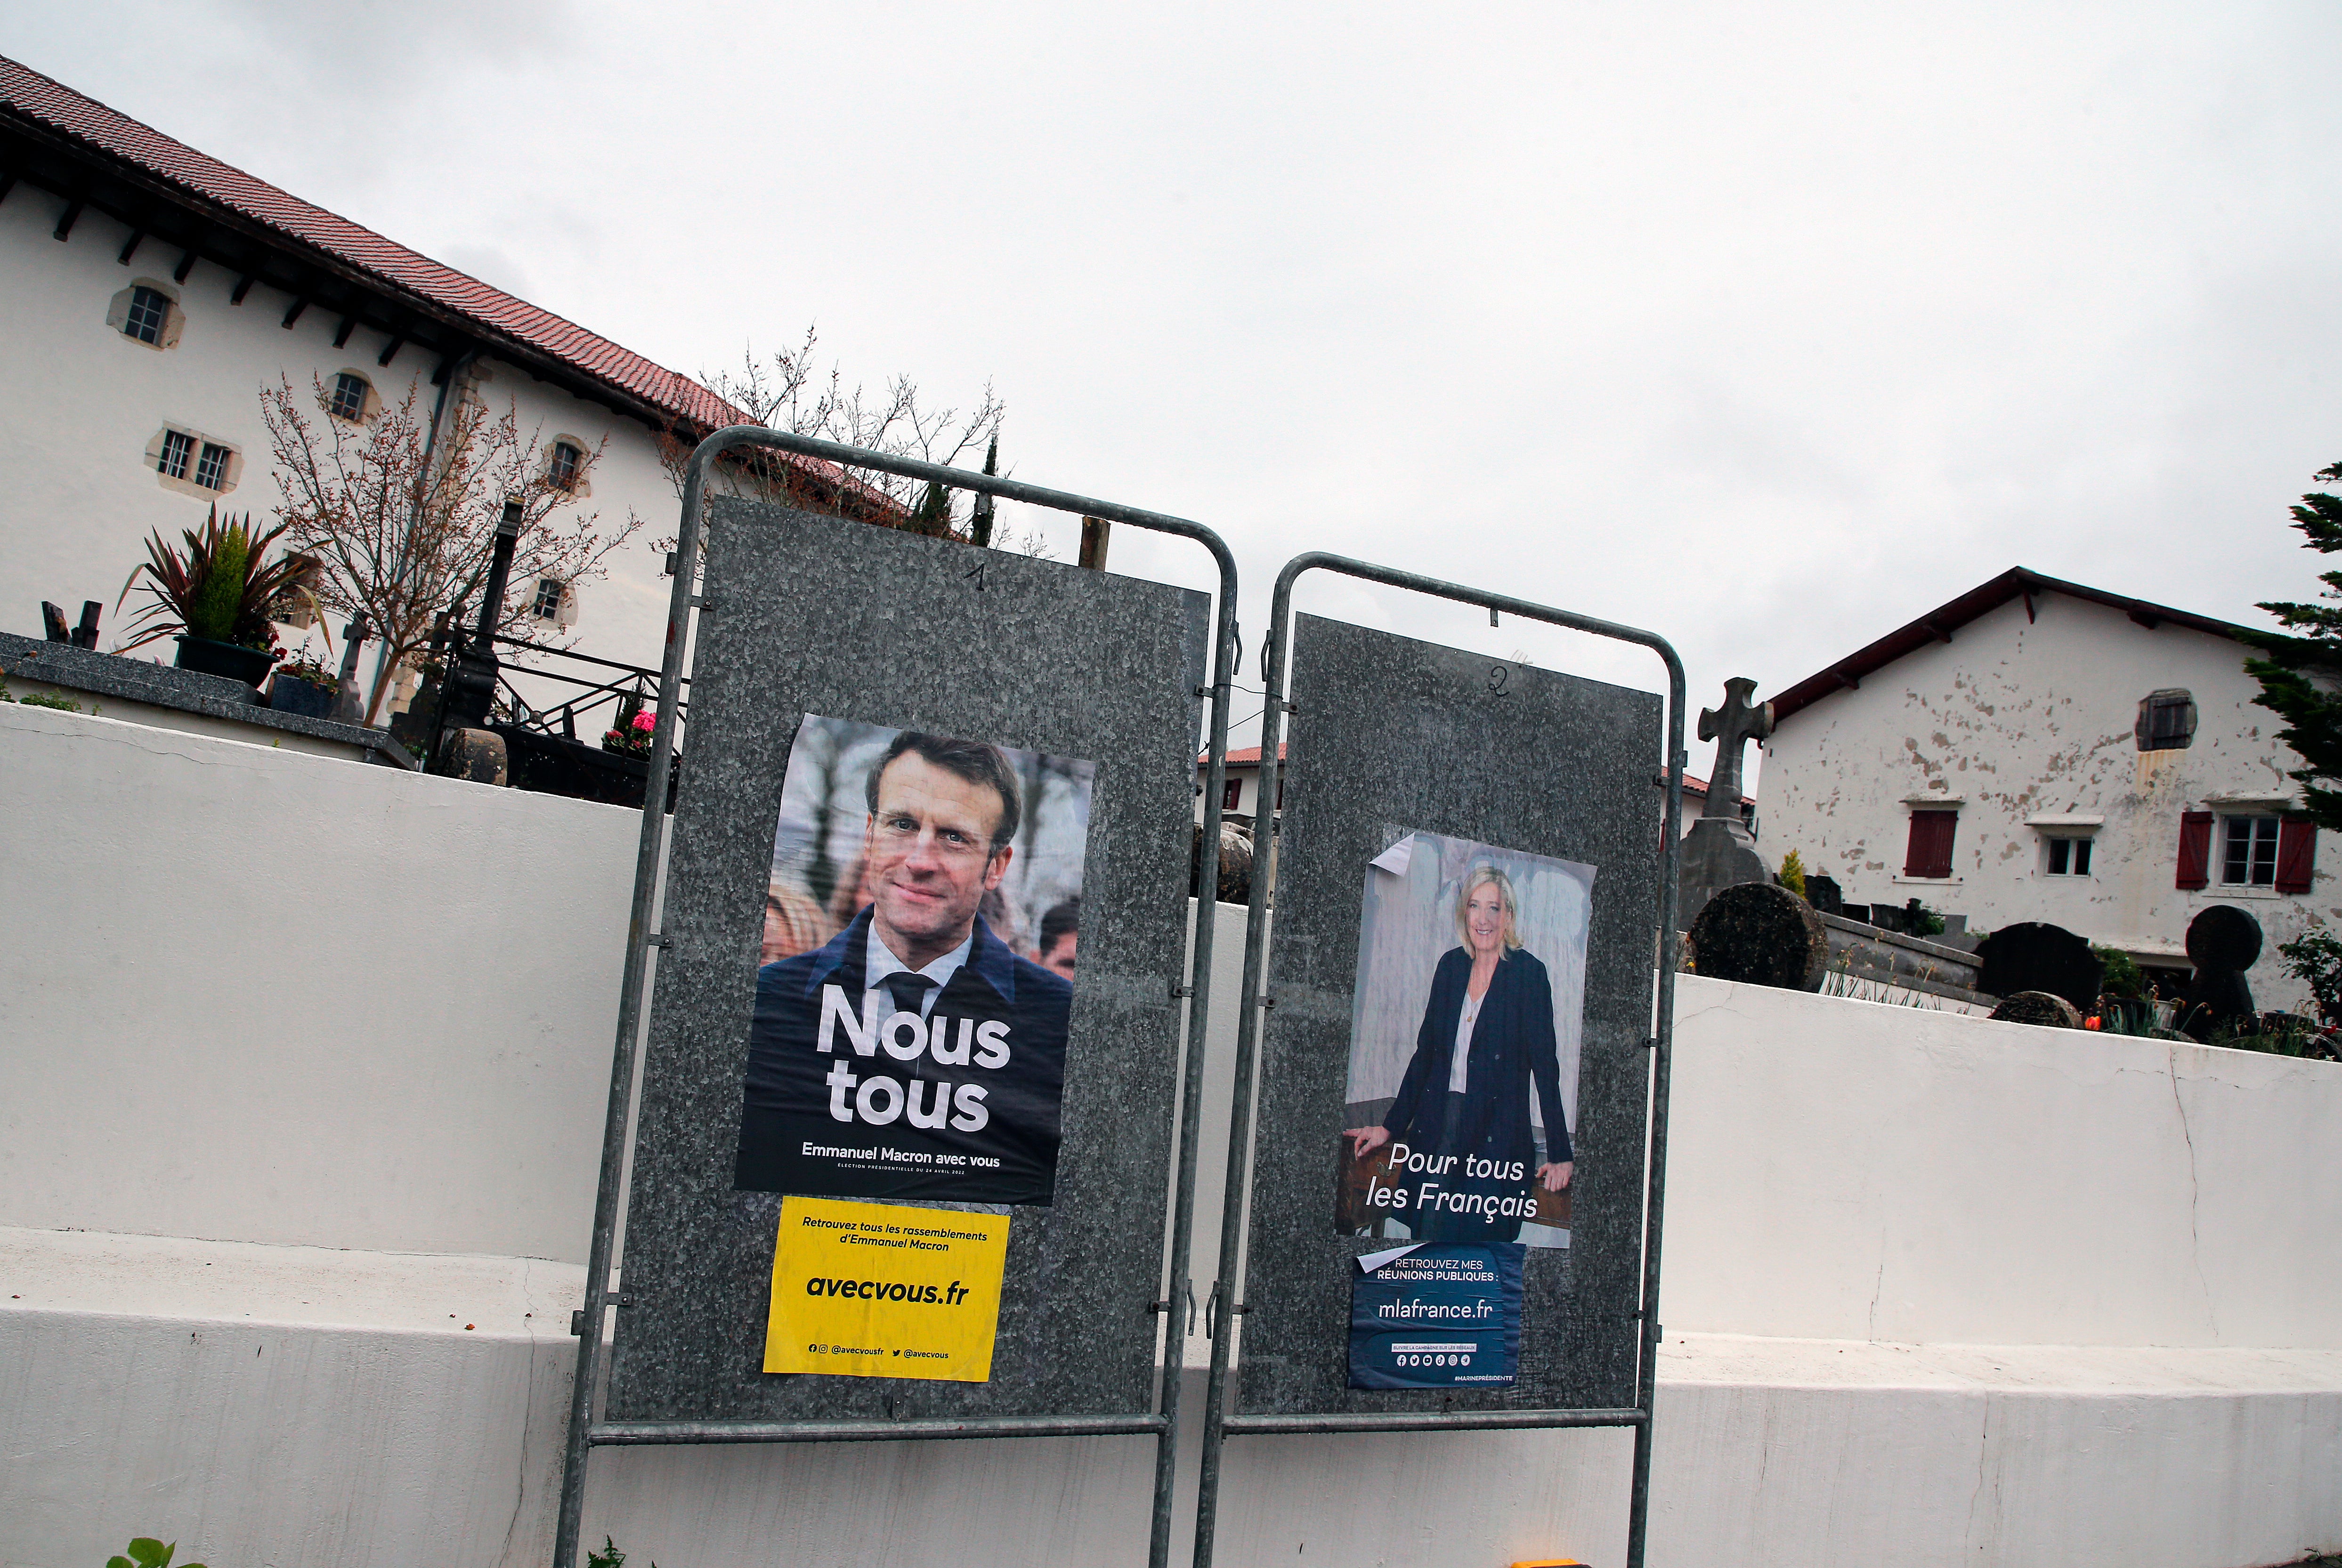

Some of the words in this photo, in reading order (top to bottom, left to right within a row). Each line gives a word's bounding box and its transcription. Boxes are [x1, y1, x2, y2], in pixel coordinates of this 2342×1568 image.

[964, 563, 985, 591] 1
[1489, 665, 1510, 697] 2
[817, 984, 1011, 1069] Nous
[826, 1059, 989, 1132] tous
[802, 1141, 877, 1160] Emmanuel
[881, 1147, 932, 1164] Macron
[935, 1154, 966, 1166] avec
[970, 1156, 1000, 1168] vous
[1388, 1143, 1458, 1174] Pour
[1466, 1153, 1524, 1181] tous
[1366, 1176, 1408, 1208] les
[1416, 1182, 1538, 1224] Français
[802, 1216, 857, 1230] Retrouvez
[859, 1222, 883, 1233] tous
[885, 1223, 900, 1234] les
[902, 1226, 988, 1241] rassemblements
[839, 1233, 908, 1248] d'Emmanuel
[909, 1239, 949, 1252] Macron
[1377, 1267, 1434, 1280] RÉUNIONS
[1395, 1259, 1459, 1269] RETROUVEZ
[1461, 1260, 1483, 1270] MES
[806, 1277, 970, 1305] avecvous.fr
[1378, 1298, 1493, 1318] mlafrance.fr
[831, 1345, 884, 1356] @avecvousfr
[903, 1349, 949, 1359] @avecvous
